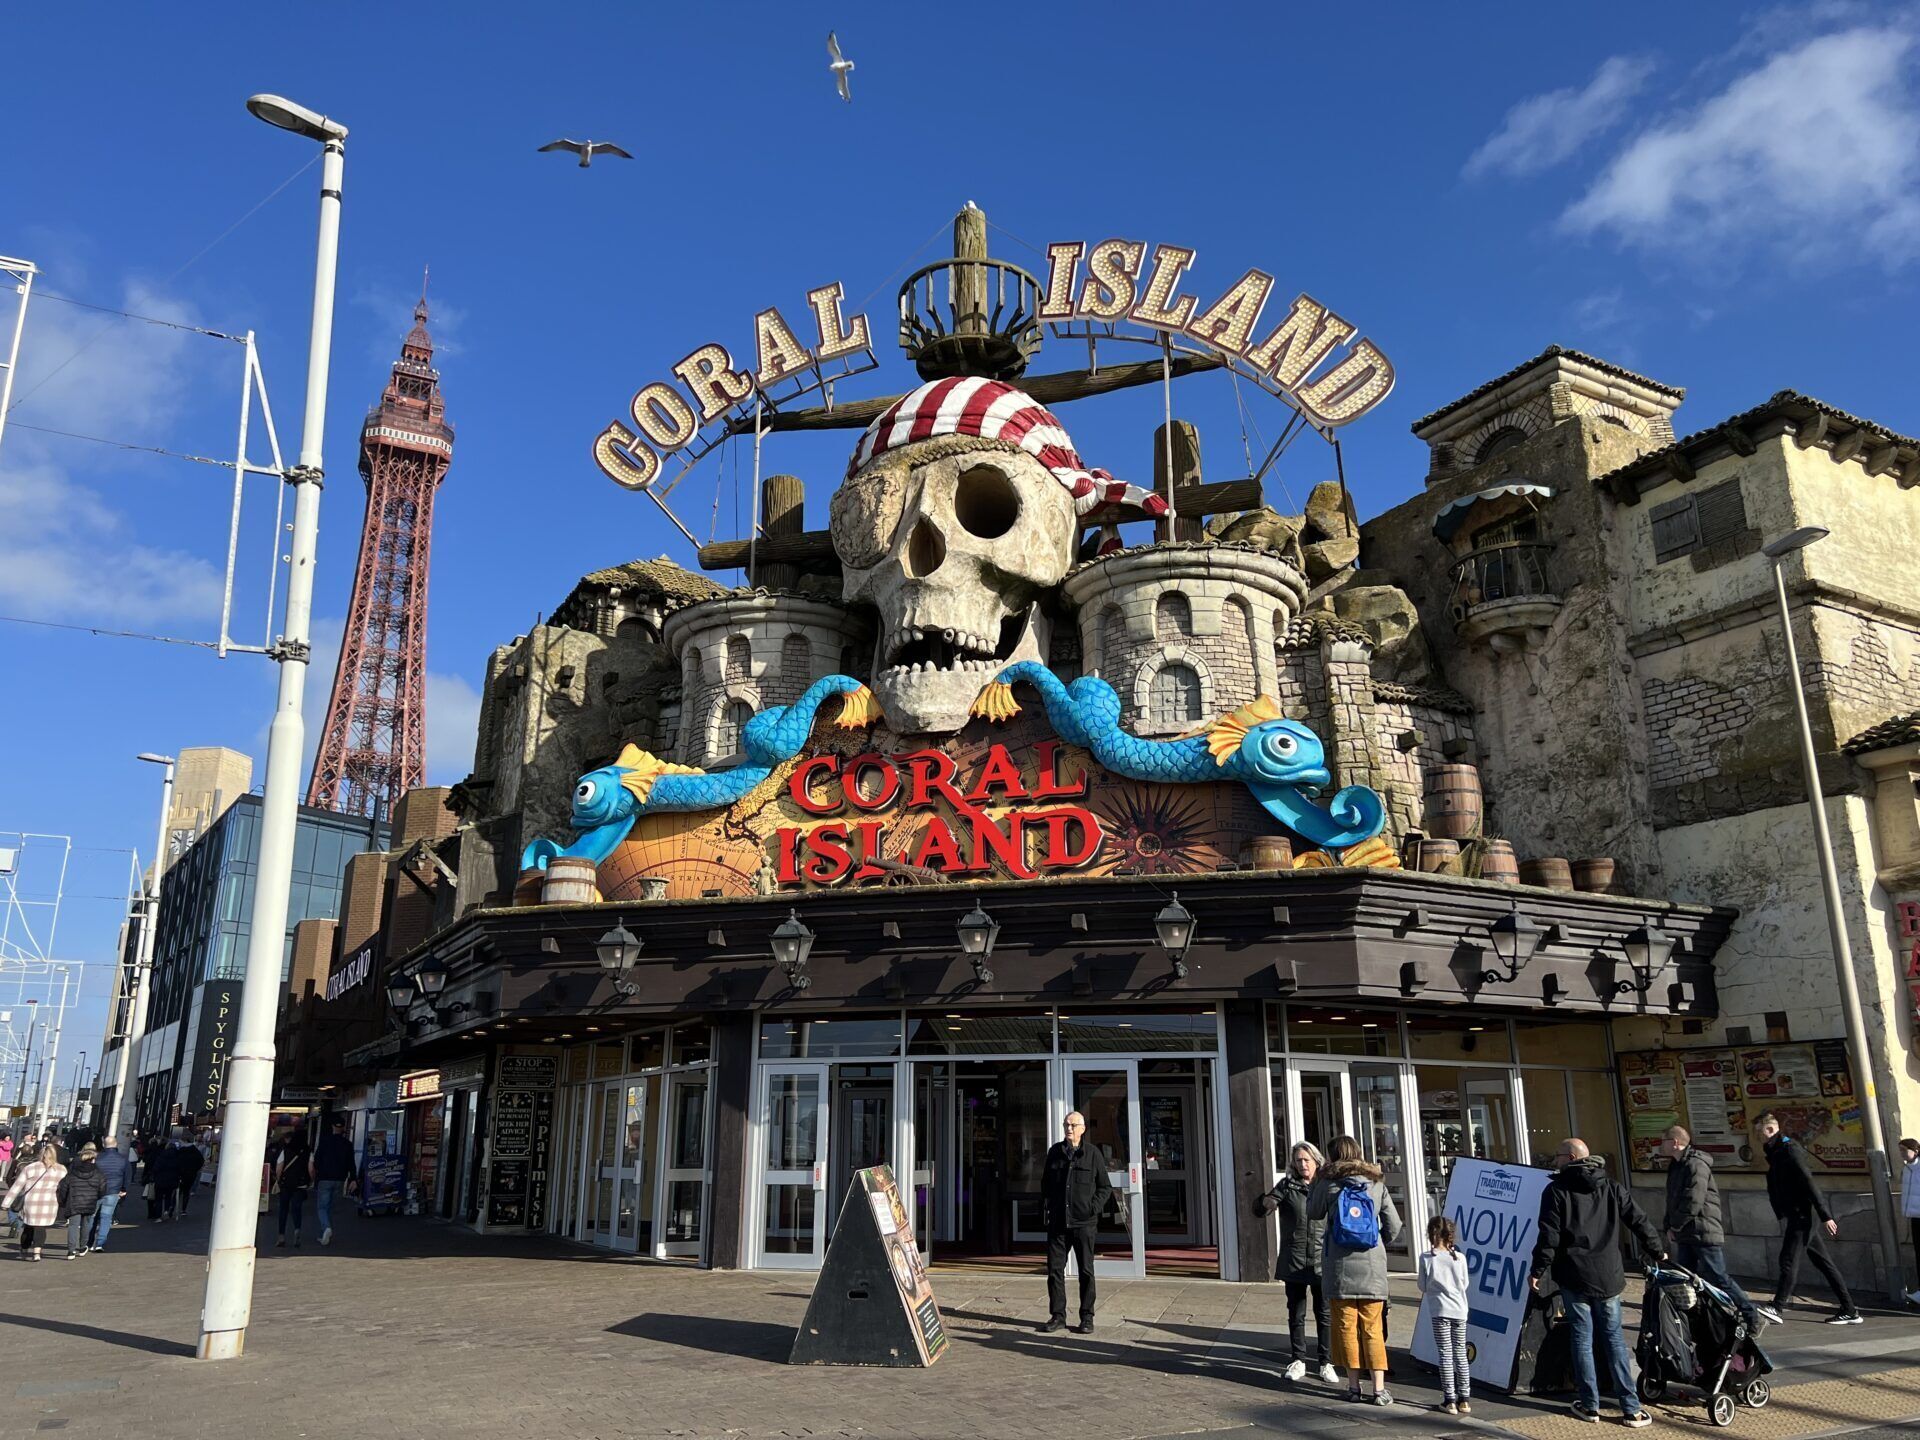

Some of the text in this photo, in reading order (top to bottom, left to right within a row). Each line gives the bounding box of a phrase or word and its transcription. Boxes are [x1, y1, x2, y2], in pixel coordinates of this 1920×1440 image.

[593, 238, 1396, 490] CORAL ISLAND
[790, 742, 1087, 813] CORAL
[776, 807, 1103, 884] ISLAND
[205, 992, 231, 1111] SPYGLASS
[515, 1058, 543, 1067] STOP
[532, 1125, 549, 1226] Palmist
[1480, 1177, 1516, 1192] TRADITIONAL
[1454, 1205, 1531, 1252] NOW
[1455, 1245, 1527, 1300] PEN
